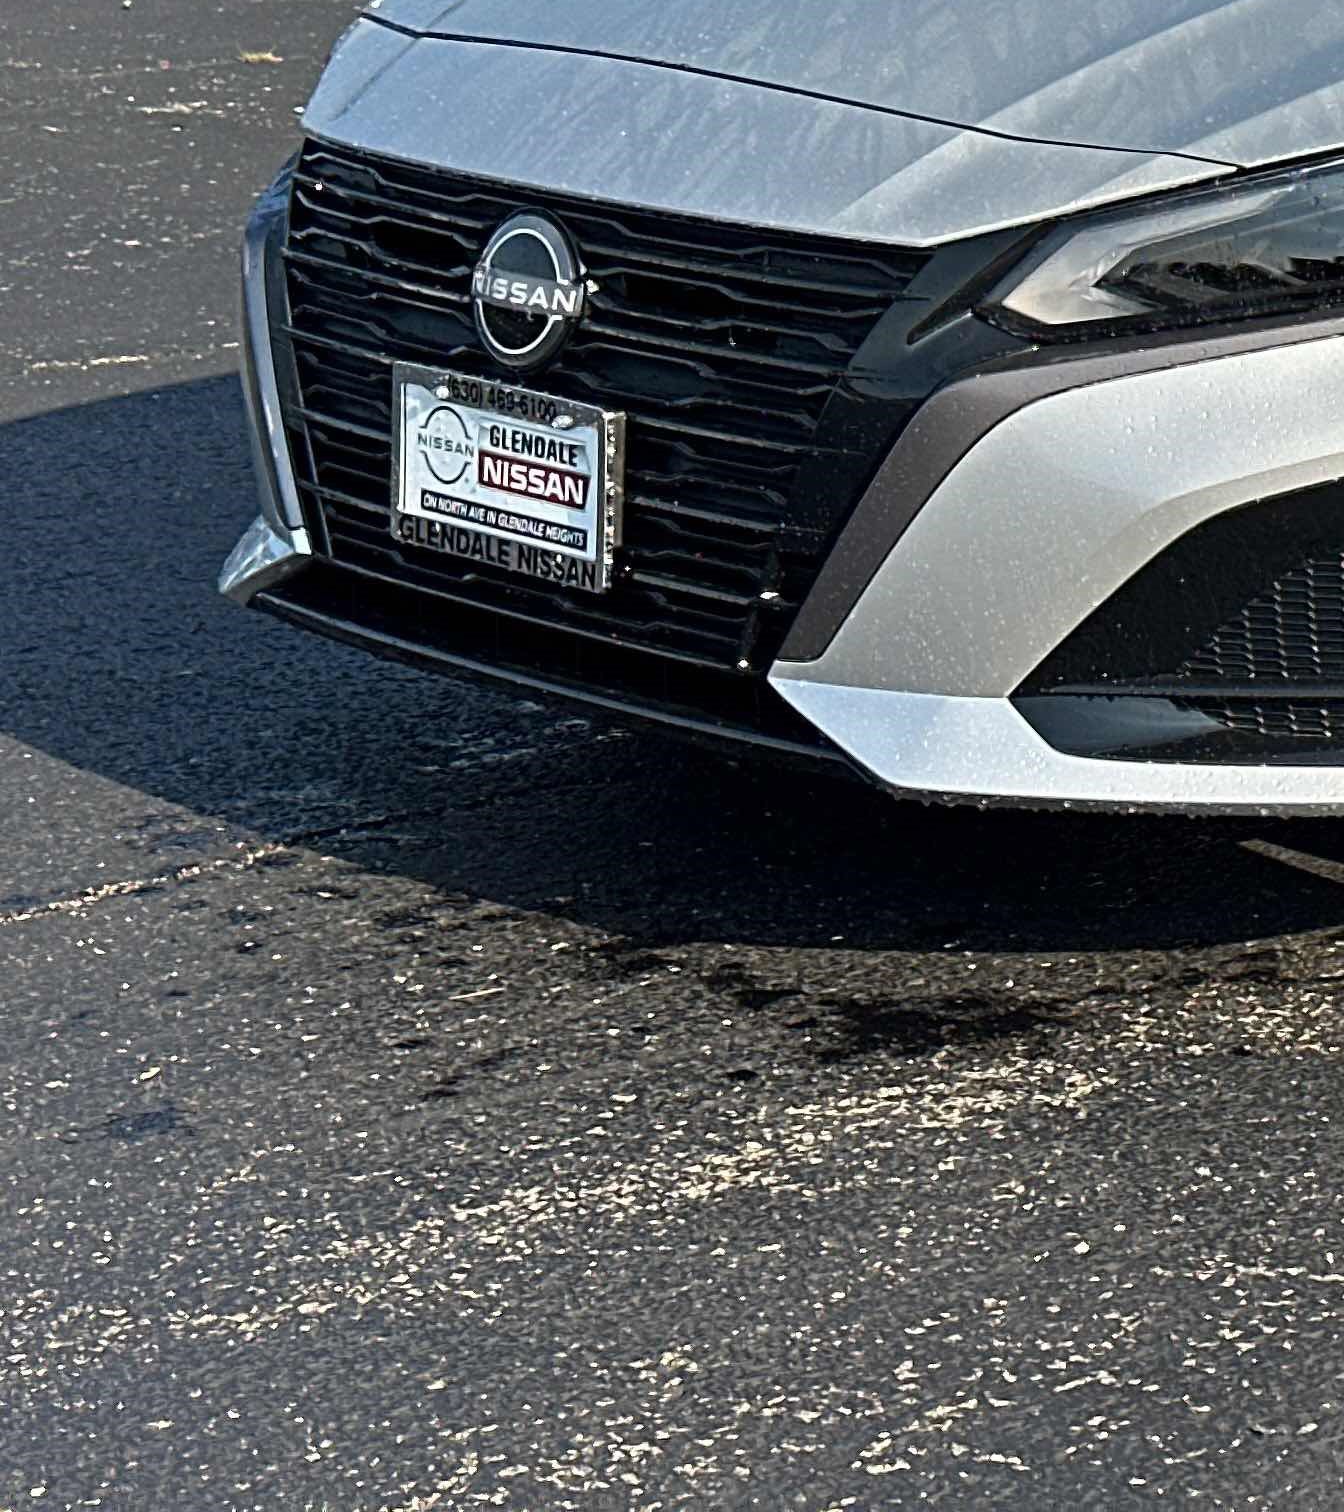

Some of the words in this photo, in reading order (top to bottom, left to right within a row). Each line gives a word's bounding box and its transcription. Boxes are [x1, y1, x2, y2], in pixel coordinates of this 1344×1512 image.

[472, 271, 577, 313] NISSAN
[417, 432, 475, 459] NISSAN
[489, 424, 579, 467] GLENDALE
[483, 457, 585, 505] NISSAN
[422, 494, 437, 508] ON
[437, 497, 468, 518] NORTH
[468, 507, 485, 522] AVE
[487, 510, 497, 525] IN
[497, 513, 546, 538] GLENDALE
[545, 526, 585, 547] HEIGHTS
[399, 514, 512, 567] GLENDALE
[517, 543, 597, 590] NISSAN
